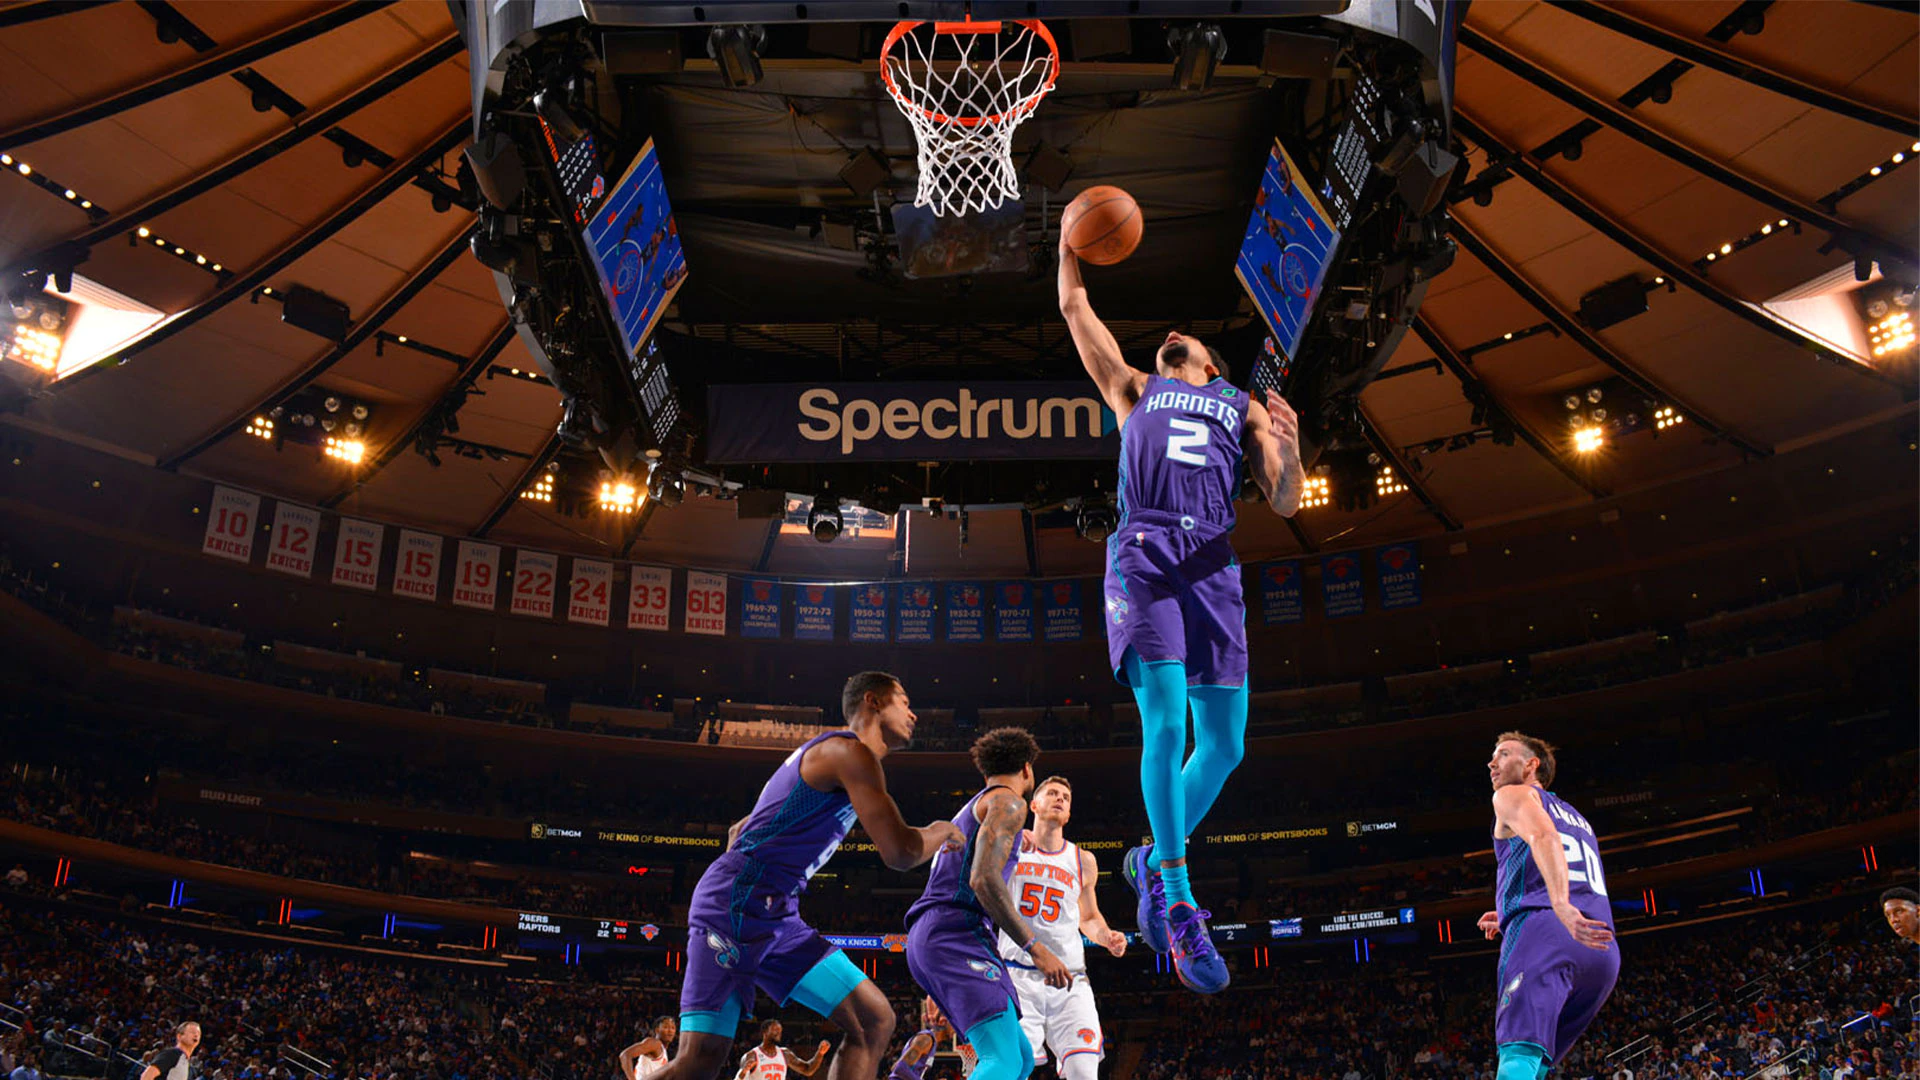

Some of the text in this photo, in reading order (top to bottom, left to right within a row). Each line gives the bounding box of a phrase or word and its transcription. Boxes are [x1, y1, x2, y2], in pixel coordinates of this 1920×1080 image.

[798, 387, 1100, 455] Spectrum
[1145, 392, 1239, 432] HORNETS
[1166, 417, 1210, 466] 2
[216, 508, 248, 537] 10
[206, 536, 249, 557] KNICKS
[278, 524, 309, 554] 12
[343, 539, 374, 566] 15
[270, 552, 311, 572] KNICKS
[404, 550, 434, 578] 15
[335, 567, 375, 586] KNICKS
[463, 560, 490, 587] 19
[396, 578, 435, 596] KNICKS
[518, 570, 552, 596] 22
[574, 578, 607, 604] 24
[456, 589, 493, 605] KNICKS
[514, 598, 551, 613] KNICKS
[634, 584, 666, 609] 33
[688, 590, 724, 614] 613
[571, 606, 607, 621] KNICKS
[745, 603, 778, 613] 1969-70
[799, 606, 832, 616] 1972-73
[854, 609, 885, 618] 1950-51
[630, 613, 666, 626] KNICKS
[687, 617, 724, 630] KNICKS
[200, 789, 261, 806] BUD LIGHT
[546, 828, 582, 838] BETMGM
[1206, 828, 1328, 844] THE KING OF SPORTSBOOKS
[1362, 822, 1397, 832] BETMGM
[598, 832, 720, 848] THE KING OF SPORTSBOOKS
[1557, 832, 1608, 896] 20
[1016, 862, 1074, 890] NEW YORK
[1019, 882, 1064, 922] 55
[518, 914, 548, 923] 76ERS
[1333, 915, 1346, 923] LIKE
[1360, 911, 1384, 920] KNICKS!
[518, 922, 560, 934] RAPTORS
[597, 930, 610, 938] 22
[1226, 931, 1234, 940] 2
